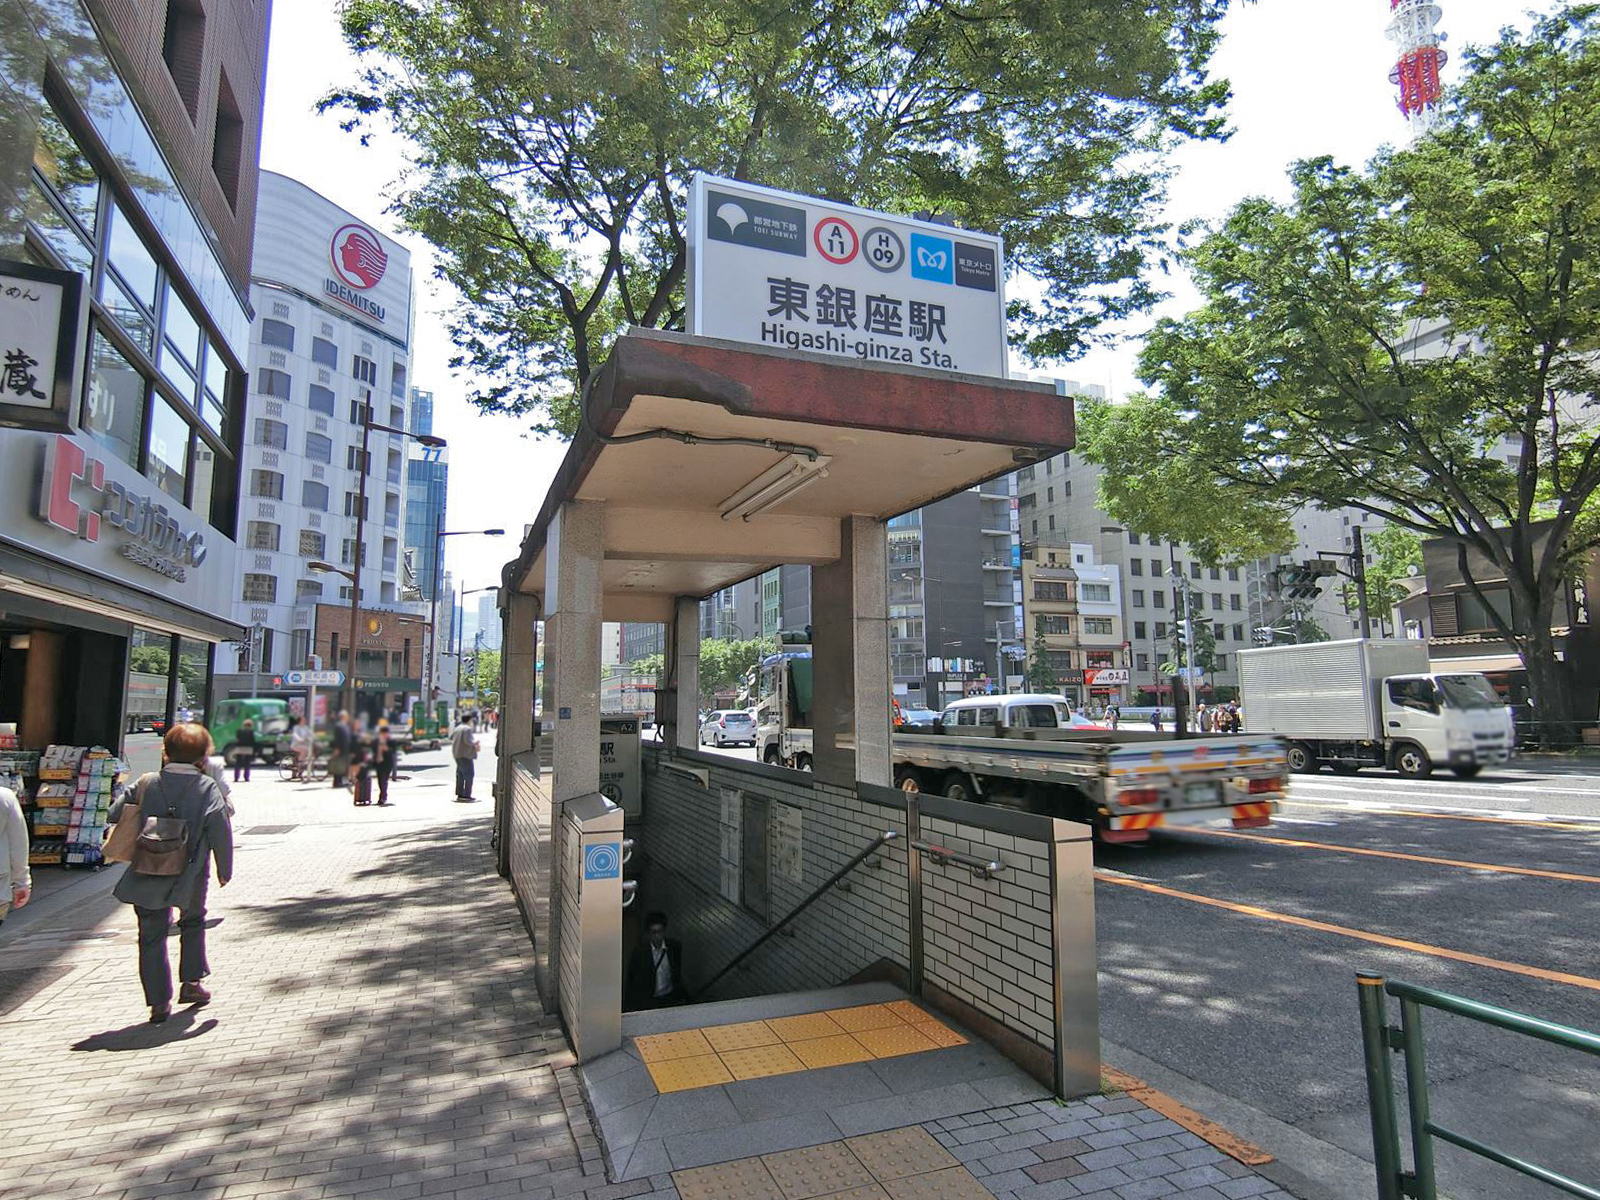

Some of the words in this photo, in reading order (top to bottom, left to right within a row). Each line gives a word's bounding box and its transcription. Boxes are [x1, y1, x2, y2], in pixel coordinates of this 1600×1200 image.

[753, 215, 798, 233] 都営地下鉄
[753, 226, 768, 235] TOEI
[770, 228, 798, 241] SUBWAY
[830, 225, 843, 239] A
[827, 239, 846, 255] 11
[878, 234, 889, 249] H
[873, 248, 894, 265] 09
[958, 257, 992, 271] 東京メトロ
[961, 265, 975, 275] Tokyo
[975, 269, 990, 277] Metro
[0, 285, 41, 302] めん
[325, 278, 386, 320] IDEMITSU
[766, 276, 948, 345] 東銀座駅
[760, 320, 914, 361] Higashi-ginza
[920, 346, 958, 370] Sta.
[0, 347, 47, 400] 蔵
[362, 638, 388, 646] PRONTO
[1059, 676, 1082, 684] KAIZO
[621, 723, 634, 733] A2
